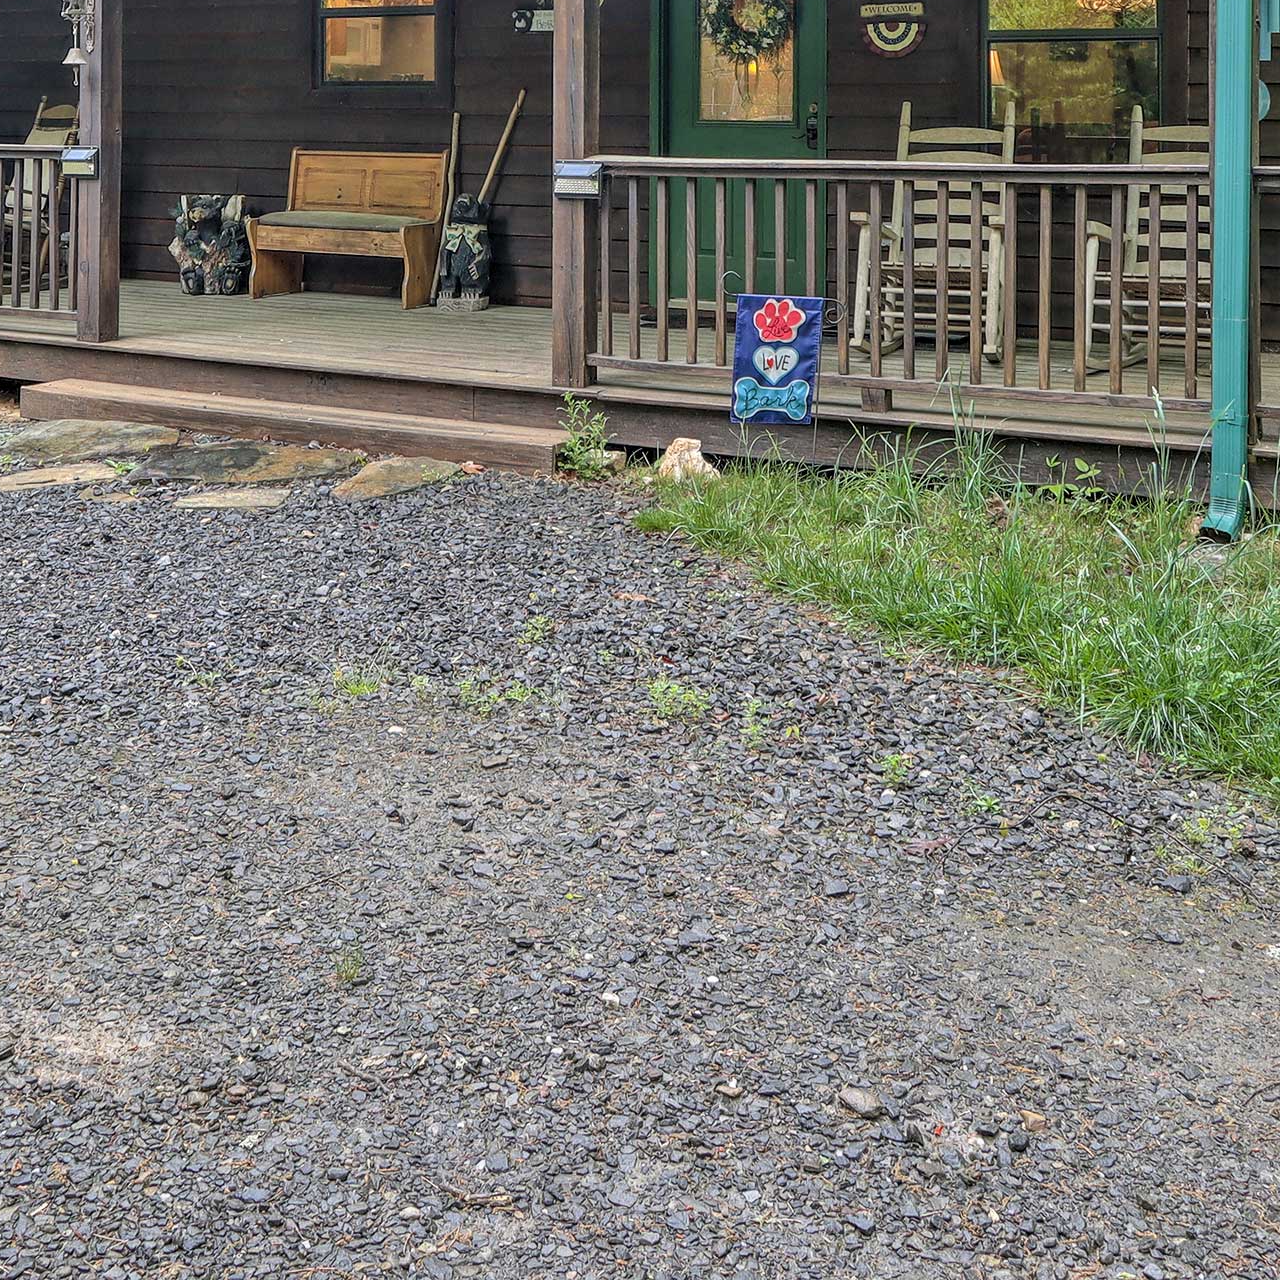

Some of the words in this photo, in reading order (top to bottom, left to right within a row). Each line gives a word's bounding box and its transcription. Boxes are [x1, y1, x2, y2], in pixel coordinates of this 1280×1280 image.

[868, 5, 914, 14] WELCOME
[762, 318, 791, 338] Live
[744, 387, 801, 411] Bark
